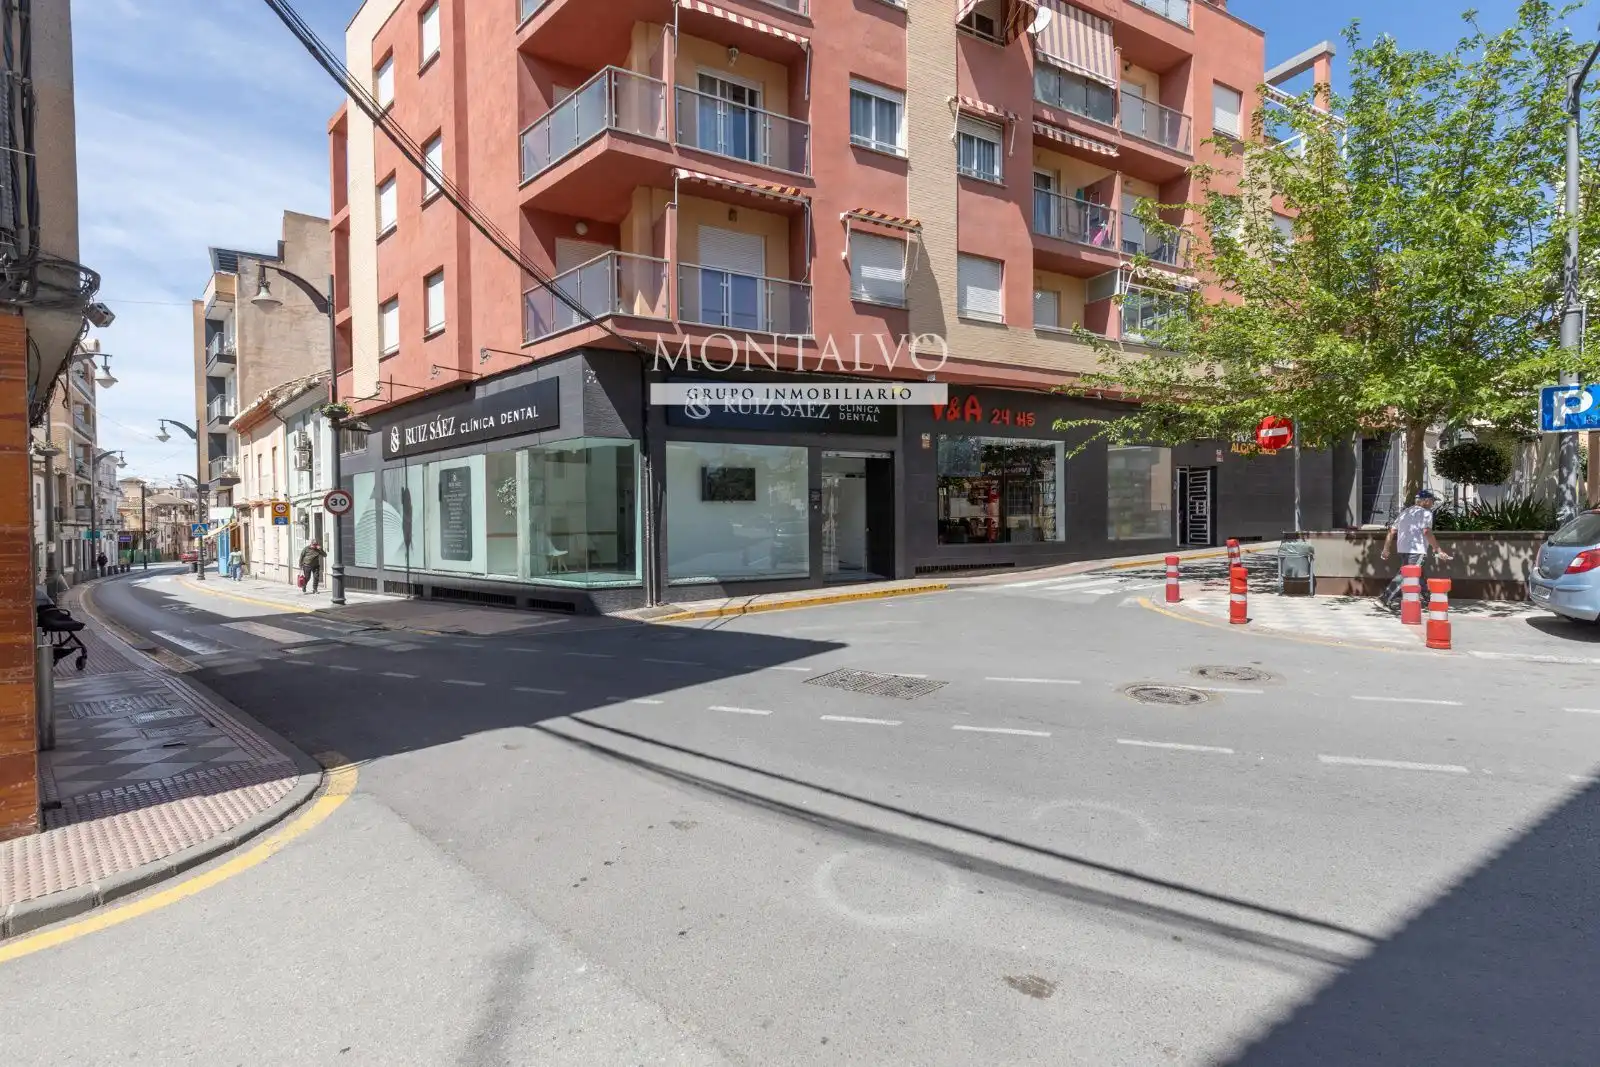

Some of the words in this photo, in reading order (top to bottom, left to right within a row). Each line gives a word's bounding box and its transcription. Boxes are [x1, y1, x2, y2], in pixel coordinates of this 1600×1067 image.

[723, 396, 775, 415] RUIZ
[1553, 390, 1593, 427] P
[405, 423, 428, 445] RUIZ
[429, 415, 456, 440] SÁEZ
[460, 416, 495, 434] CLÍNICA
[500, 405, 539, 425] DENTAL
[839, 413, 879, 422] DENTAL
[991, 408, 1011, 426] 24
[330, 498, 347, 507] 30
